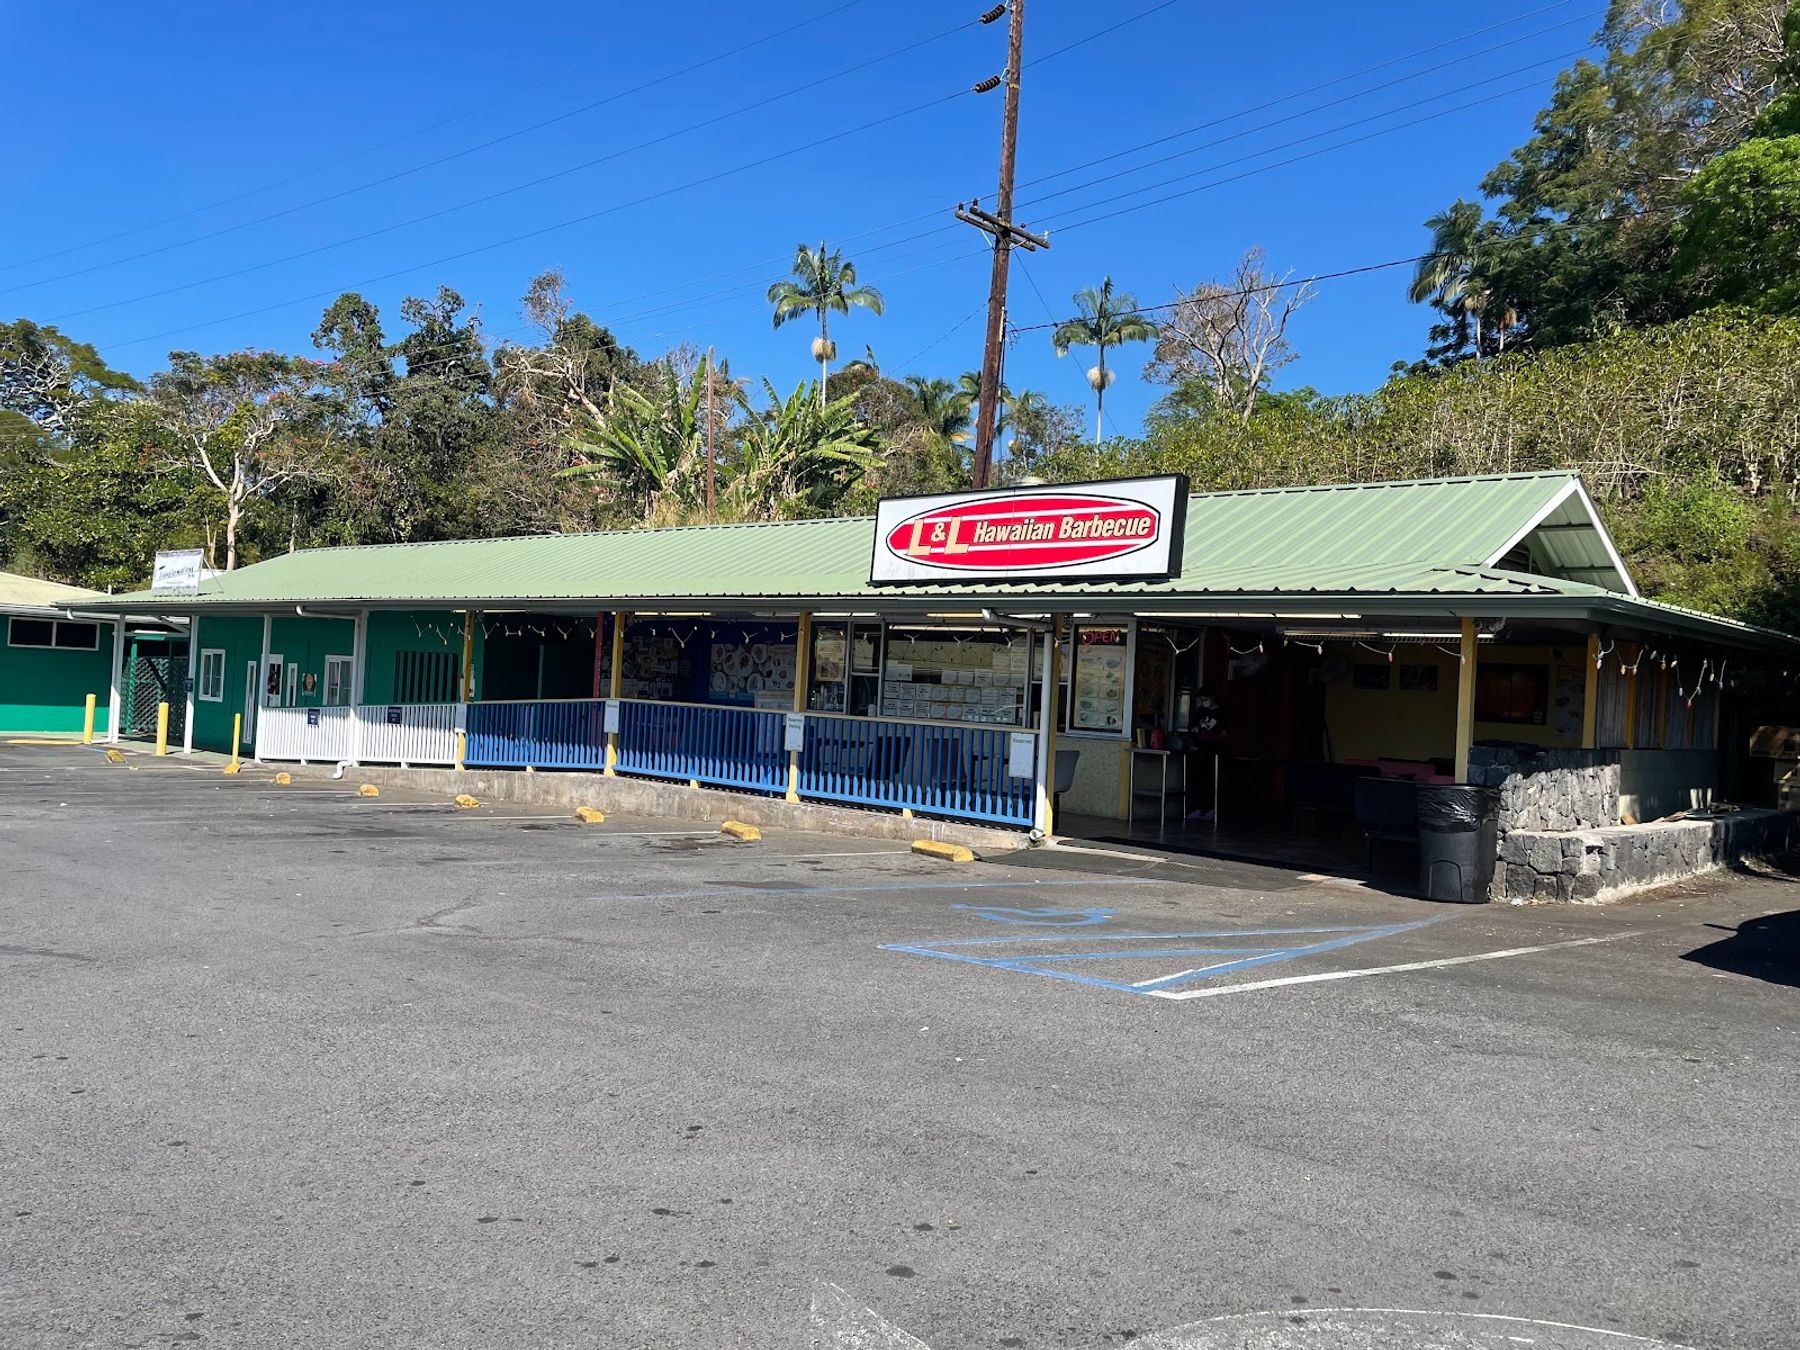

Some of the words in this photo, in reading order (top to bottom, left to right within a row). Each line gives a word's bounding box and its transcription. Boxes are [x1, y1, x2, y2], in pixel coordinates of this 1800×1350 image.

[907, 517, 970, 556] L&L
[973, 520, 1055, 543] Hawaiian
[1058, 515, 1151, 539] Barbecue
[1082, 631, 1119, 645] OPEN
